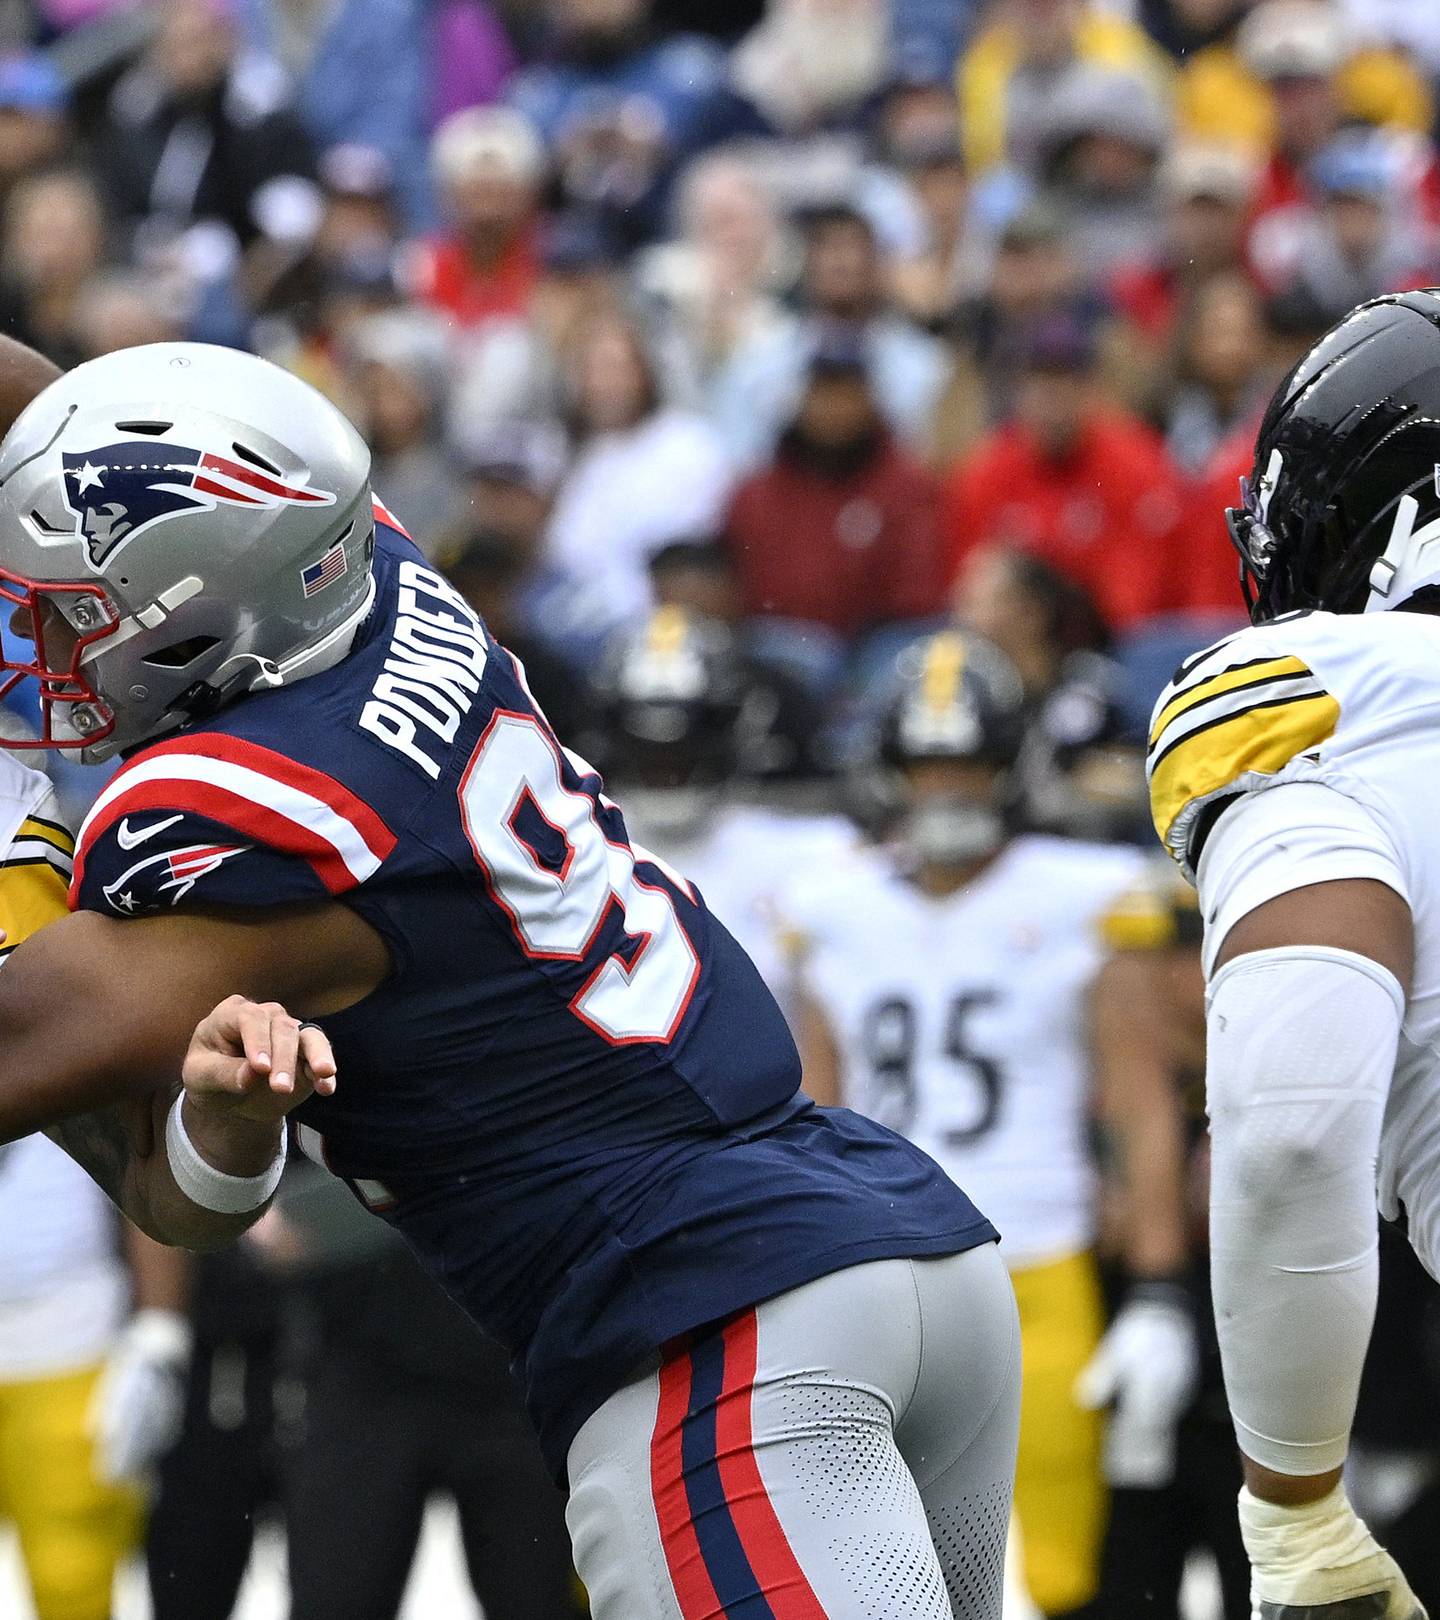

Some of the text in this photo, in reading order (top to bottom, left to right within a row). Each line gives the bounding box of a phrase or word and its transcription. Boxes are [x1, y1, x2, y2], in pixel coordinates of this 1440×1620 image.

[358, 560, 489, 781] PONDER
[456, 644, 702, 1048] 9
[861, 988, 1004, 1148] 85
